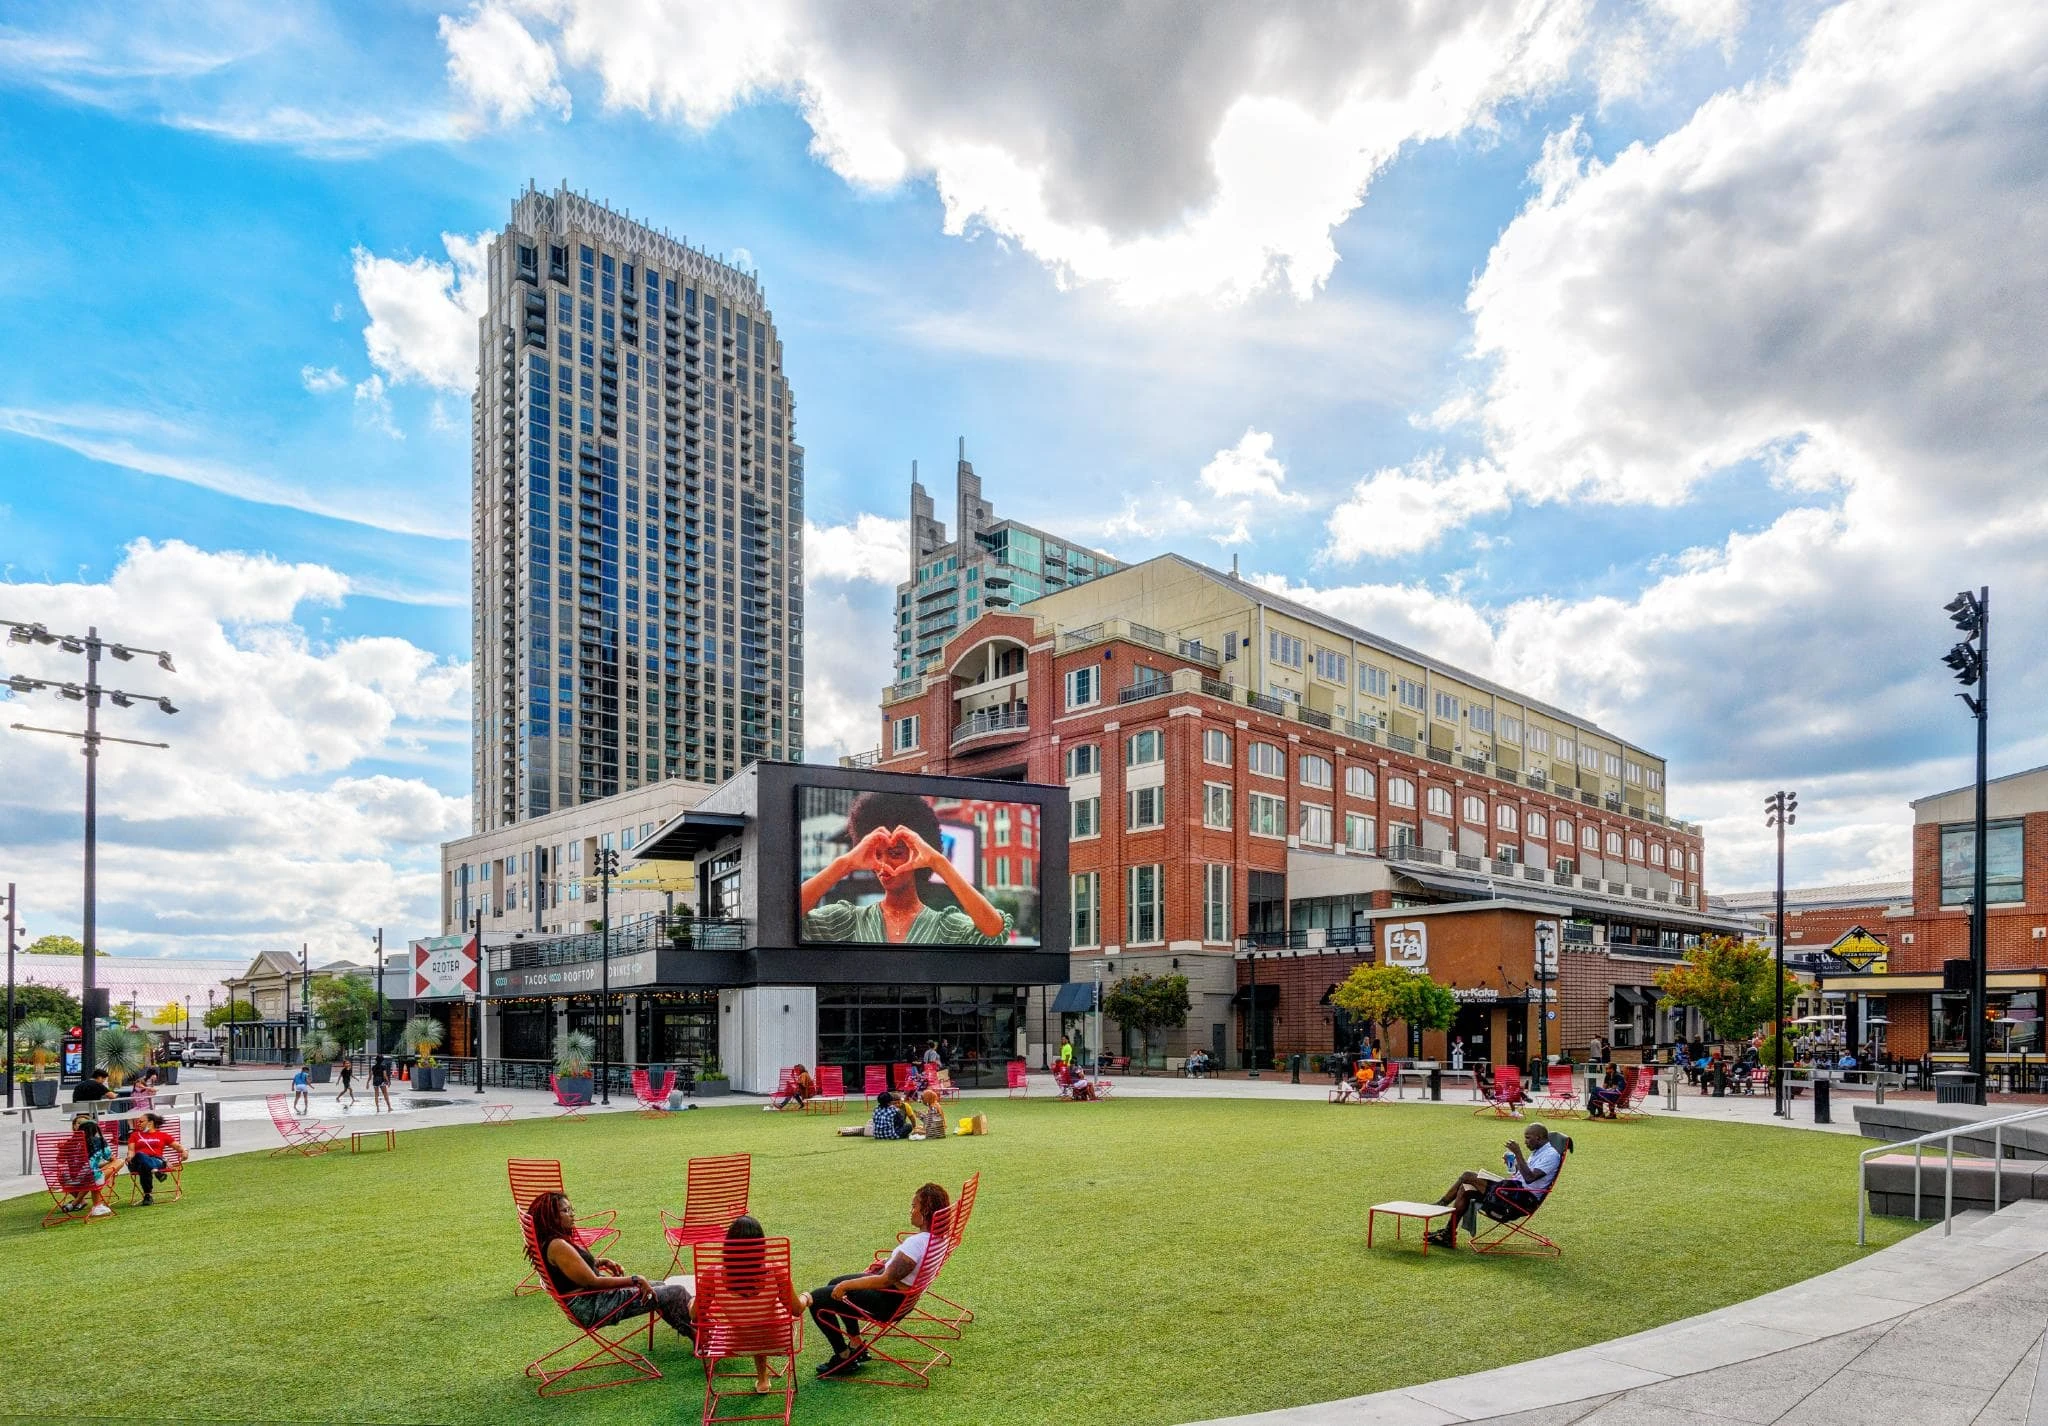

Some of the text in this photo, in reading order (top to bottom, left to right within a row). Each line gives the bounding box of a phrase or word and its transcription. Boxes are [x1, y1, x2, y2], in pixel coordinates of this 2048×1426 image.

[1838, 944, 1885, 953] california
[432, 960, 460, 973] AZOTEA
[525, 963, 630, 985] TACOS ROOFTOP DRINKS
